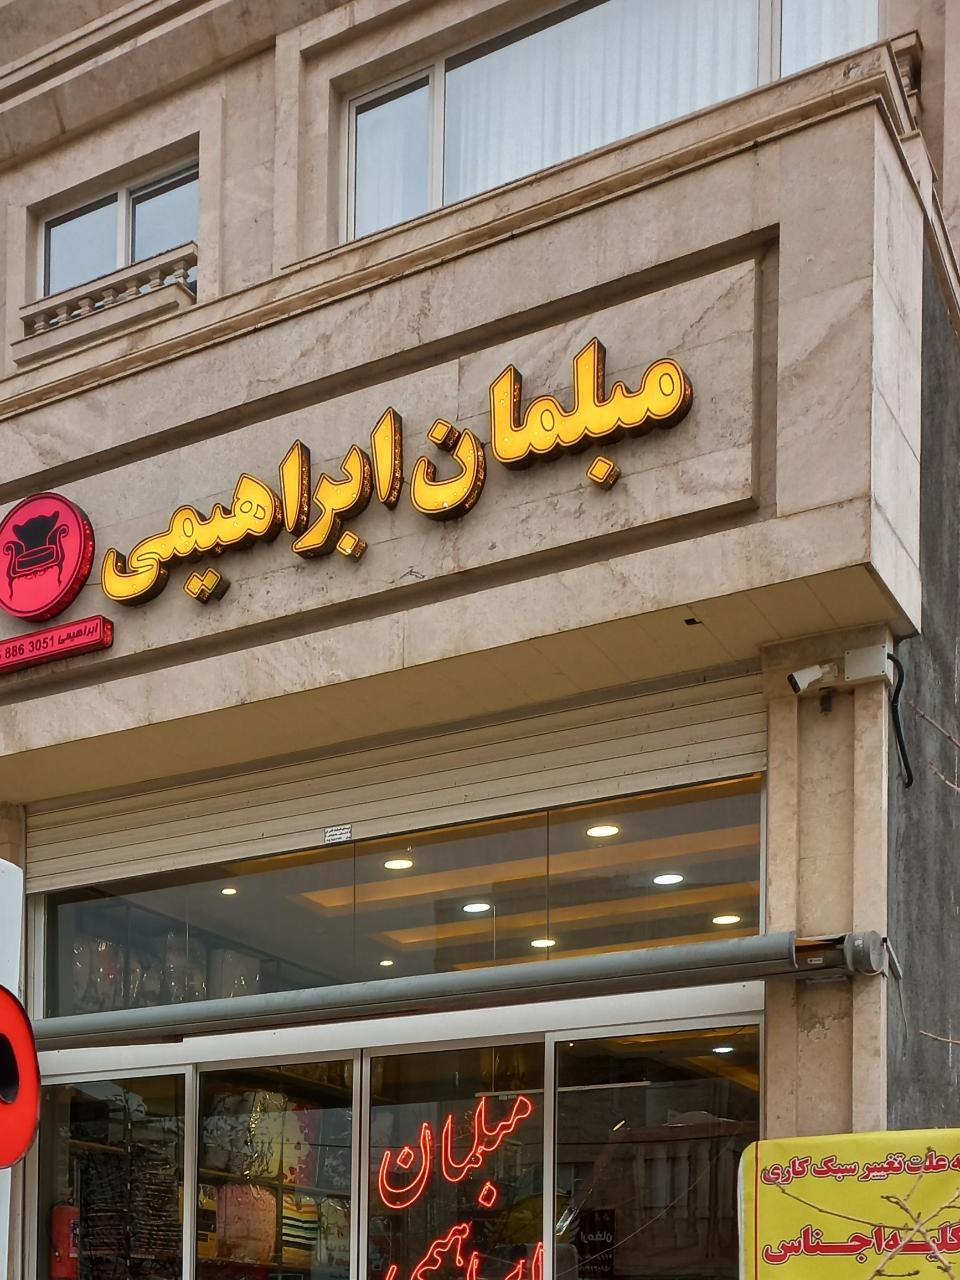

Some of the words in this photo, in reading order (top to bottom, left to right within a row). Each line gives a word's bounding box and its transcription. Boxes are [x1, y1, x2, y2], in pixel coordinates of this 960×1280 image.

[411, 336, 693, 522] مبلمان
[100, 406, 403, 606] ابراهیمی
[4, 643, 25, 659] 886
[28, 635, 55, 653] 3051
[57, 622, 99, 645] ابراهیمی
[378, 1094, 533, 1209] مبلمان
[811, 1154, 859, 1182] سبک
[858, 1152, 905, 1182] تغییر
[905, 1150, 948, 1175] علت
[762, 1156, 811, 1185] کاری
[763, 1224, 883, 1264] اجناس
